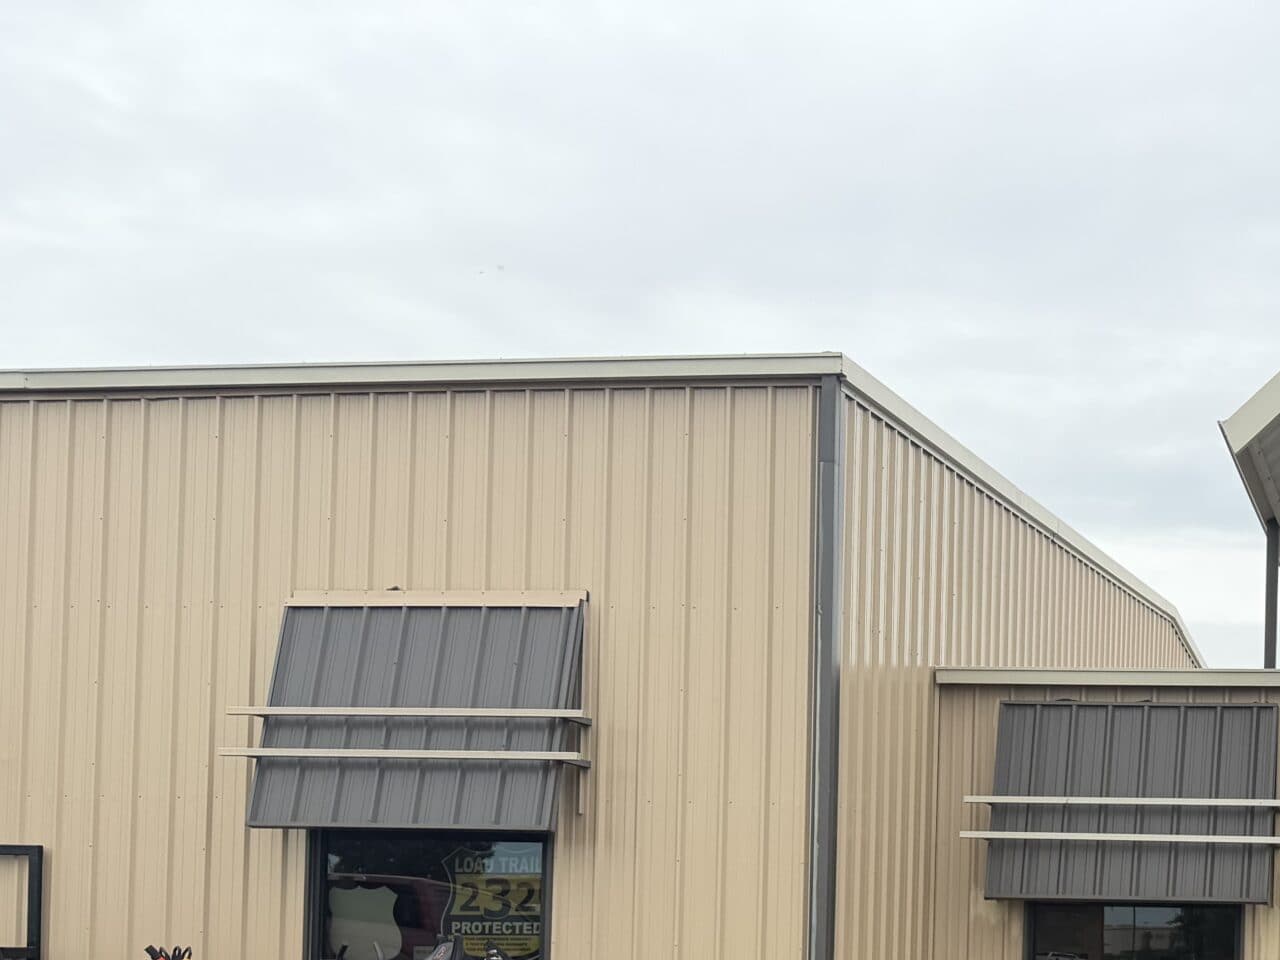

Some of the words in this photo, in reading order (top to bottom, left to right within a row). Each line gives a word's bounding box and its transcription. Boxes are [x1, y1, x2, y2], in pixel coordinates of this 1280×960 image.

[455, 856, 494, 873] LOAD
[460, 878, 538, 919] 232
[451, 921, 541, 935] PROTECTED
